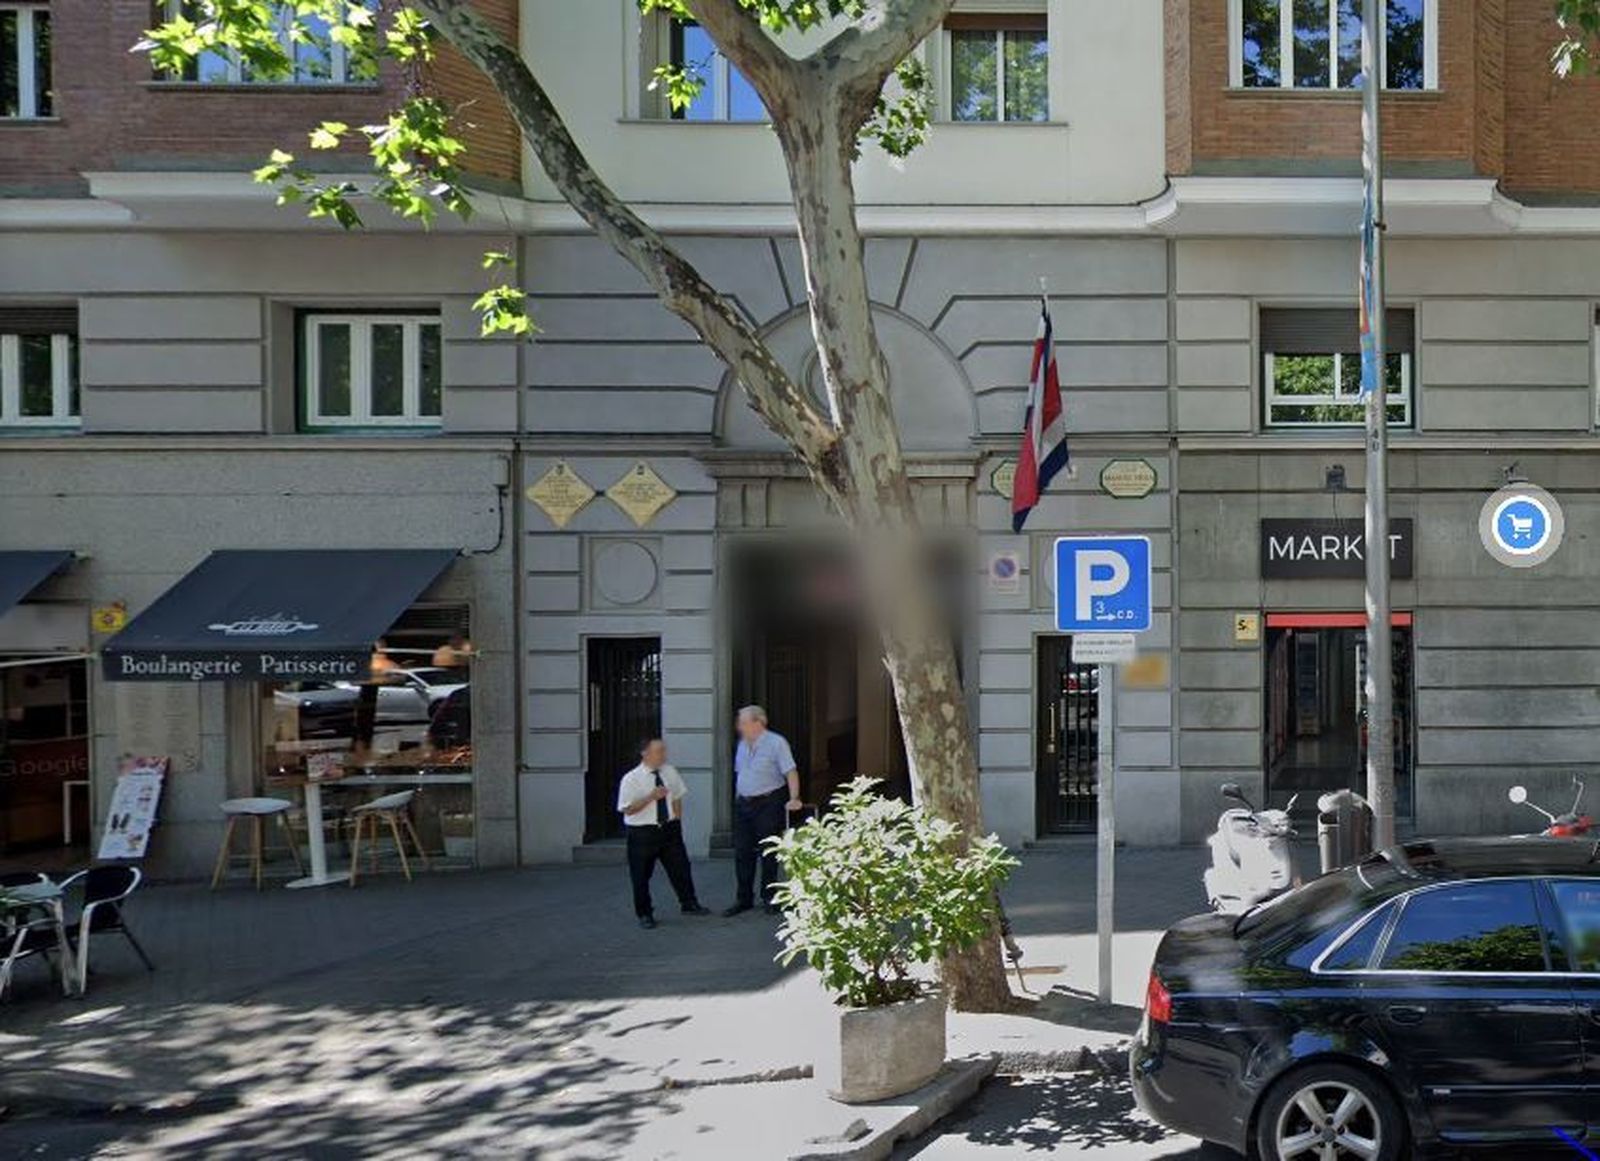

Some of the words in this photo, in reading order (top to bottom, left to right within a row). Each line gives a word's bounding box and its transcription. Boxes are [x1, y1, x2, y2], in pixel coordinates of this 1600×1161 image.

[1269, 535, 1402, 560] MARKT
[1075, 550, 1131, 620] P
[121, 655, 242, 679] Boulangerie
[260, 655, 357, 673] Patisserie
